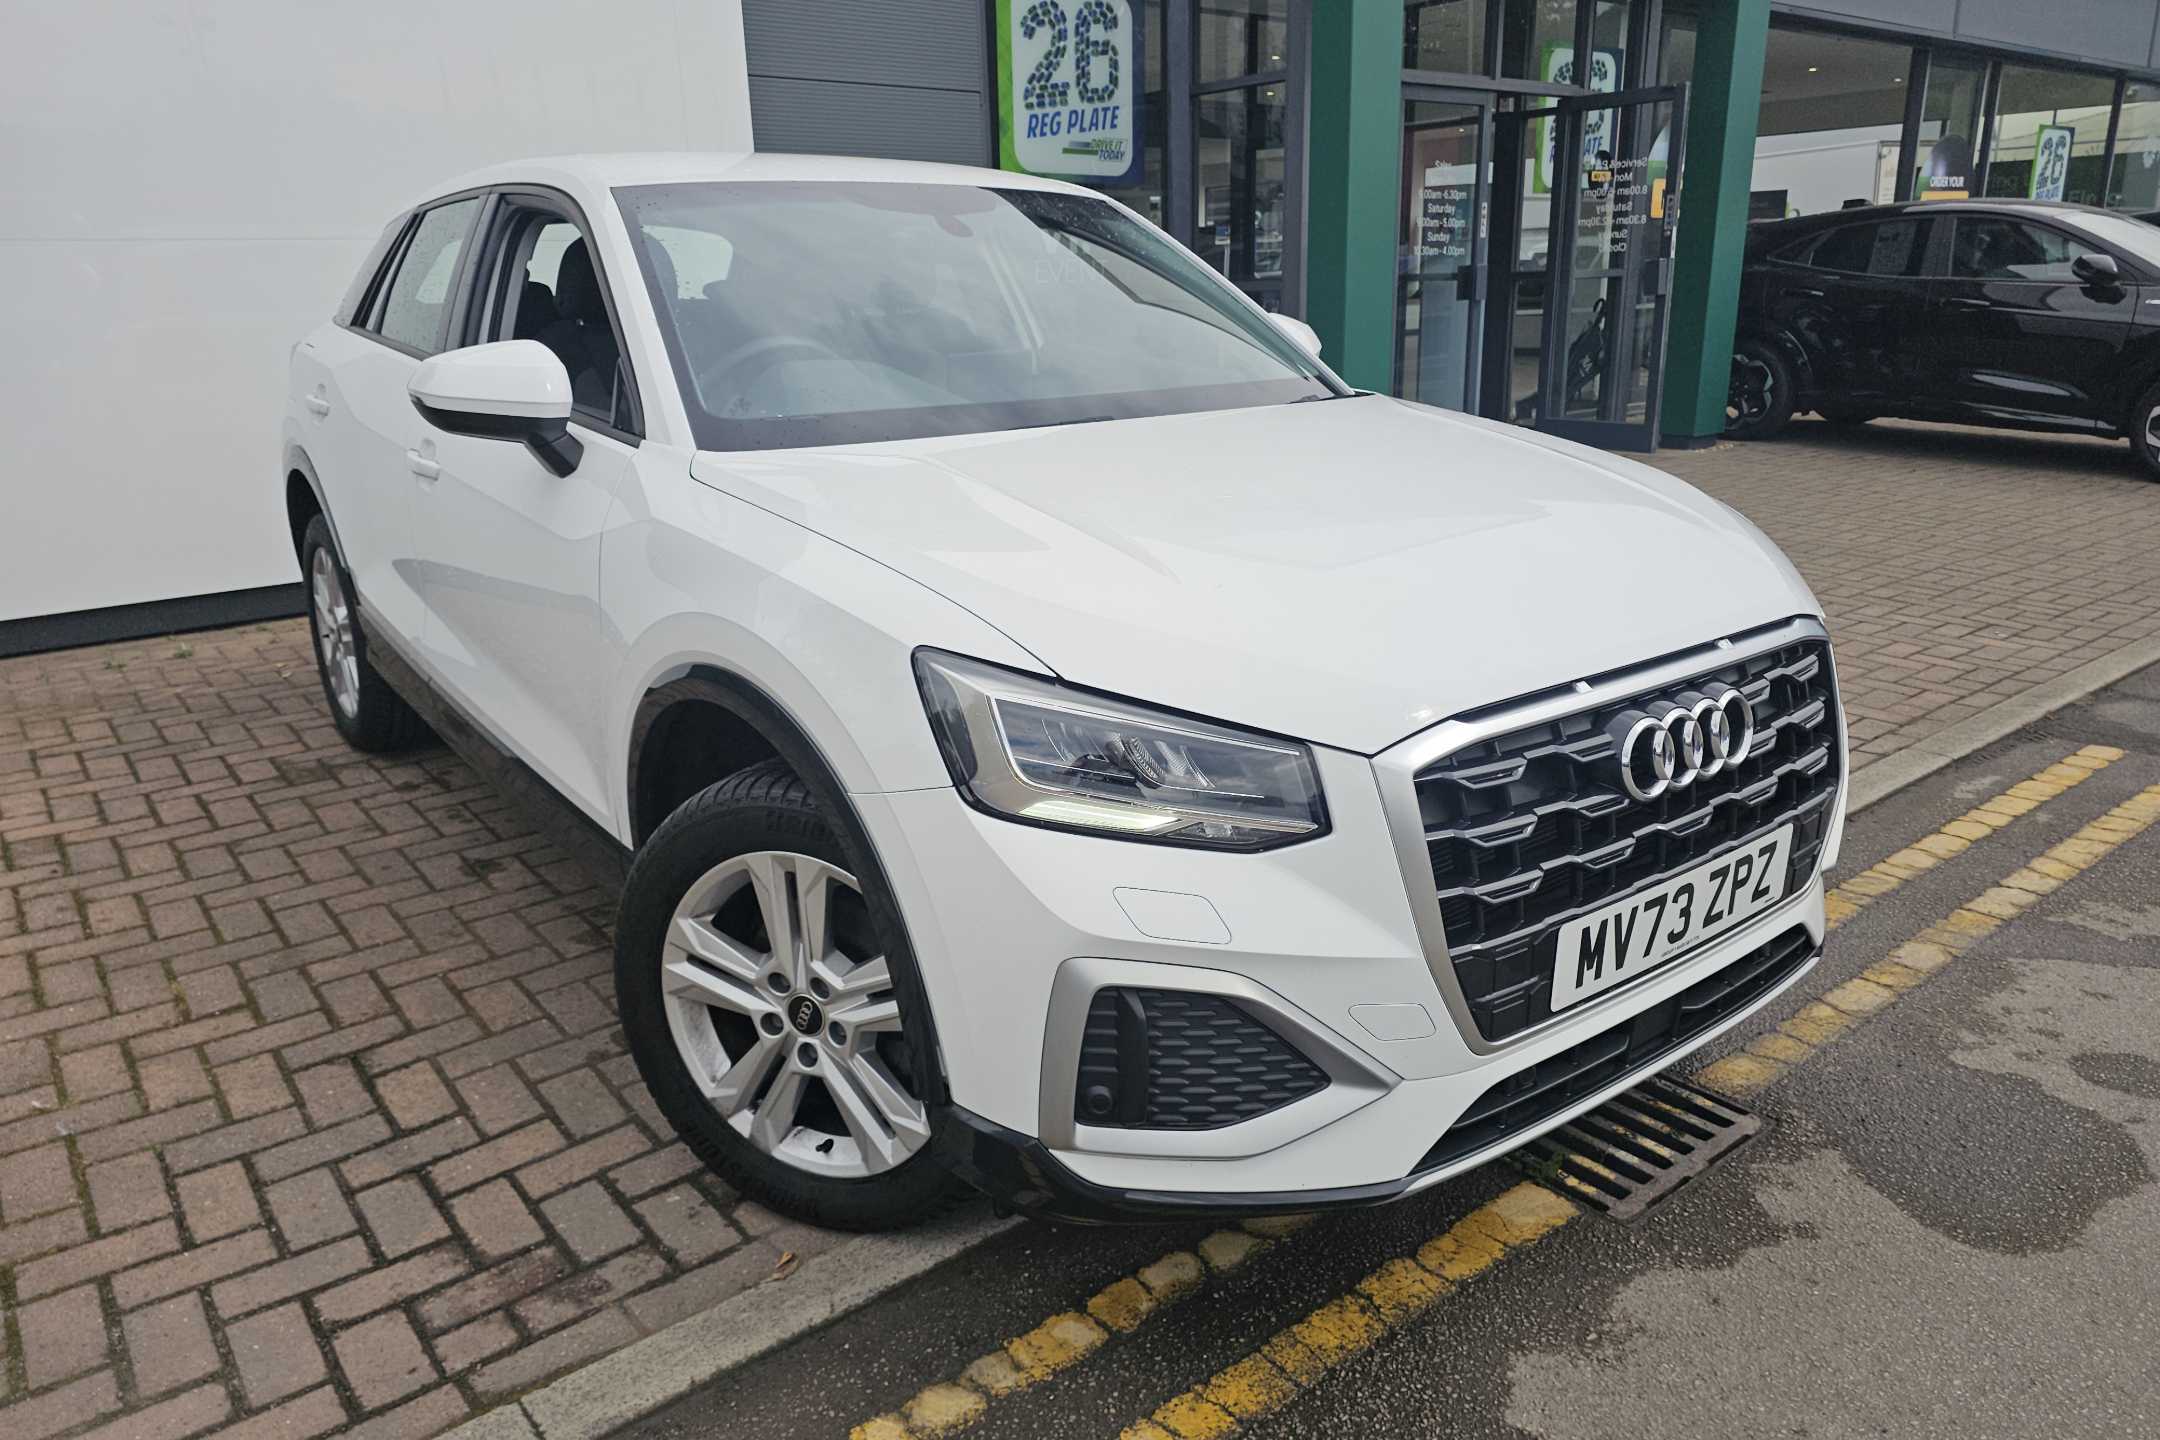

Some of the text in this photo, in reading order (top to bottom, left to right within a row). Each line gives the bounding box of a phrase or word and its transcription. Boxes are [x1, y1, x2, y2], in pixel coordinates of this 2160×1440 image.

[1020, 0, 1119, 110] 26
[1027, 106, 1120, 139] REG PLATE
[1099, 150, 1126, 161] TODAY
[1427, 203, 1456, 215] Saturday
[1427, 231, 1450, 243] Sunday
[1575, 840, 1778, 989] MV73 ZPZ
